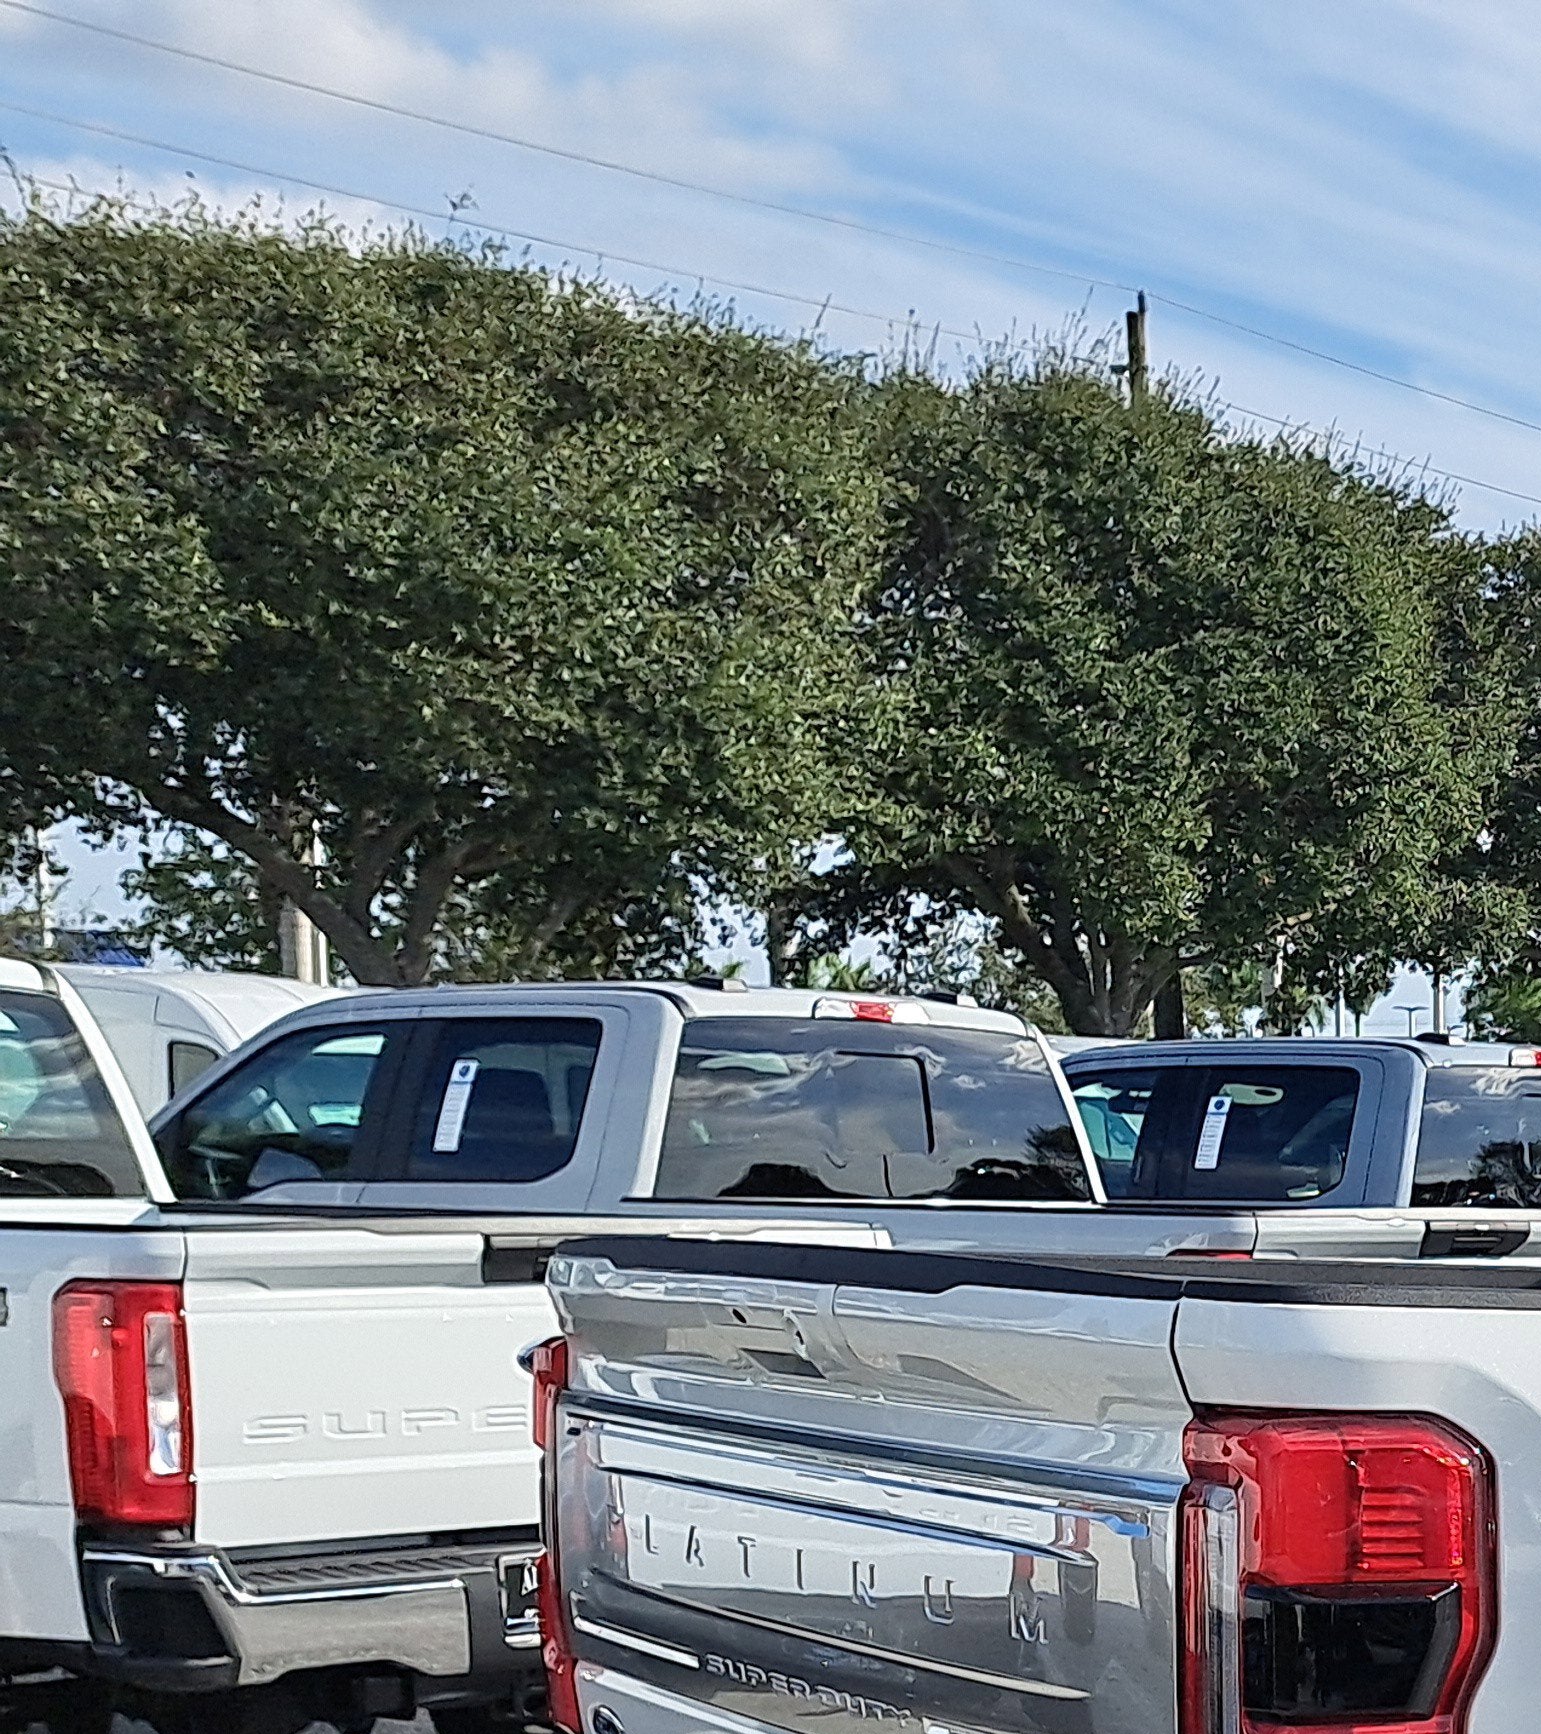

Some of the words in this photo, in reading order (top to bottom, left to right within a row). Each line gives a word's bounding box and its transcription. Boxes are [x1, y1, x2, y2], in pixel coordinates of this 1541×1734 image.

[606, 1503, 1049, 1646] PLATINUM
[704, 1652, 811, 1701] SUPER
[813, 1684, 912, 1728] DUTY
